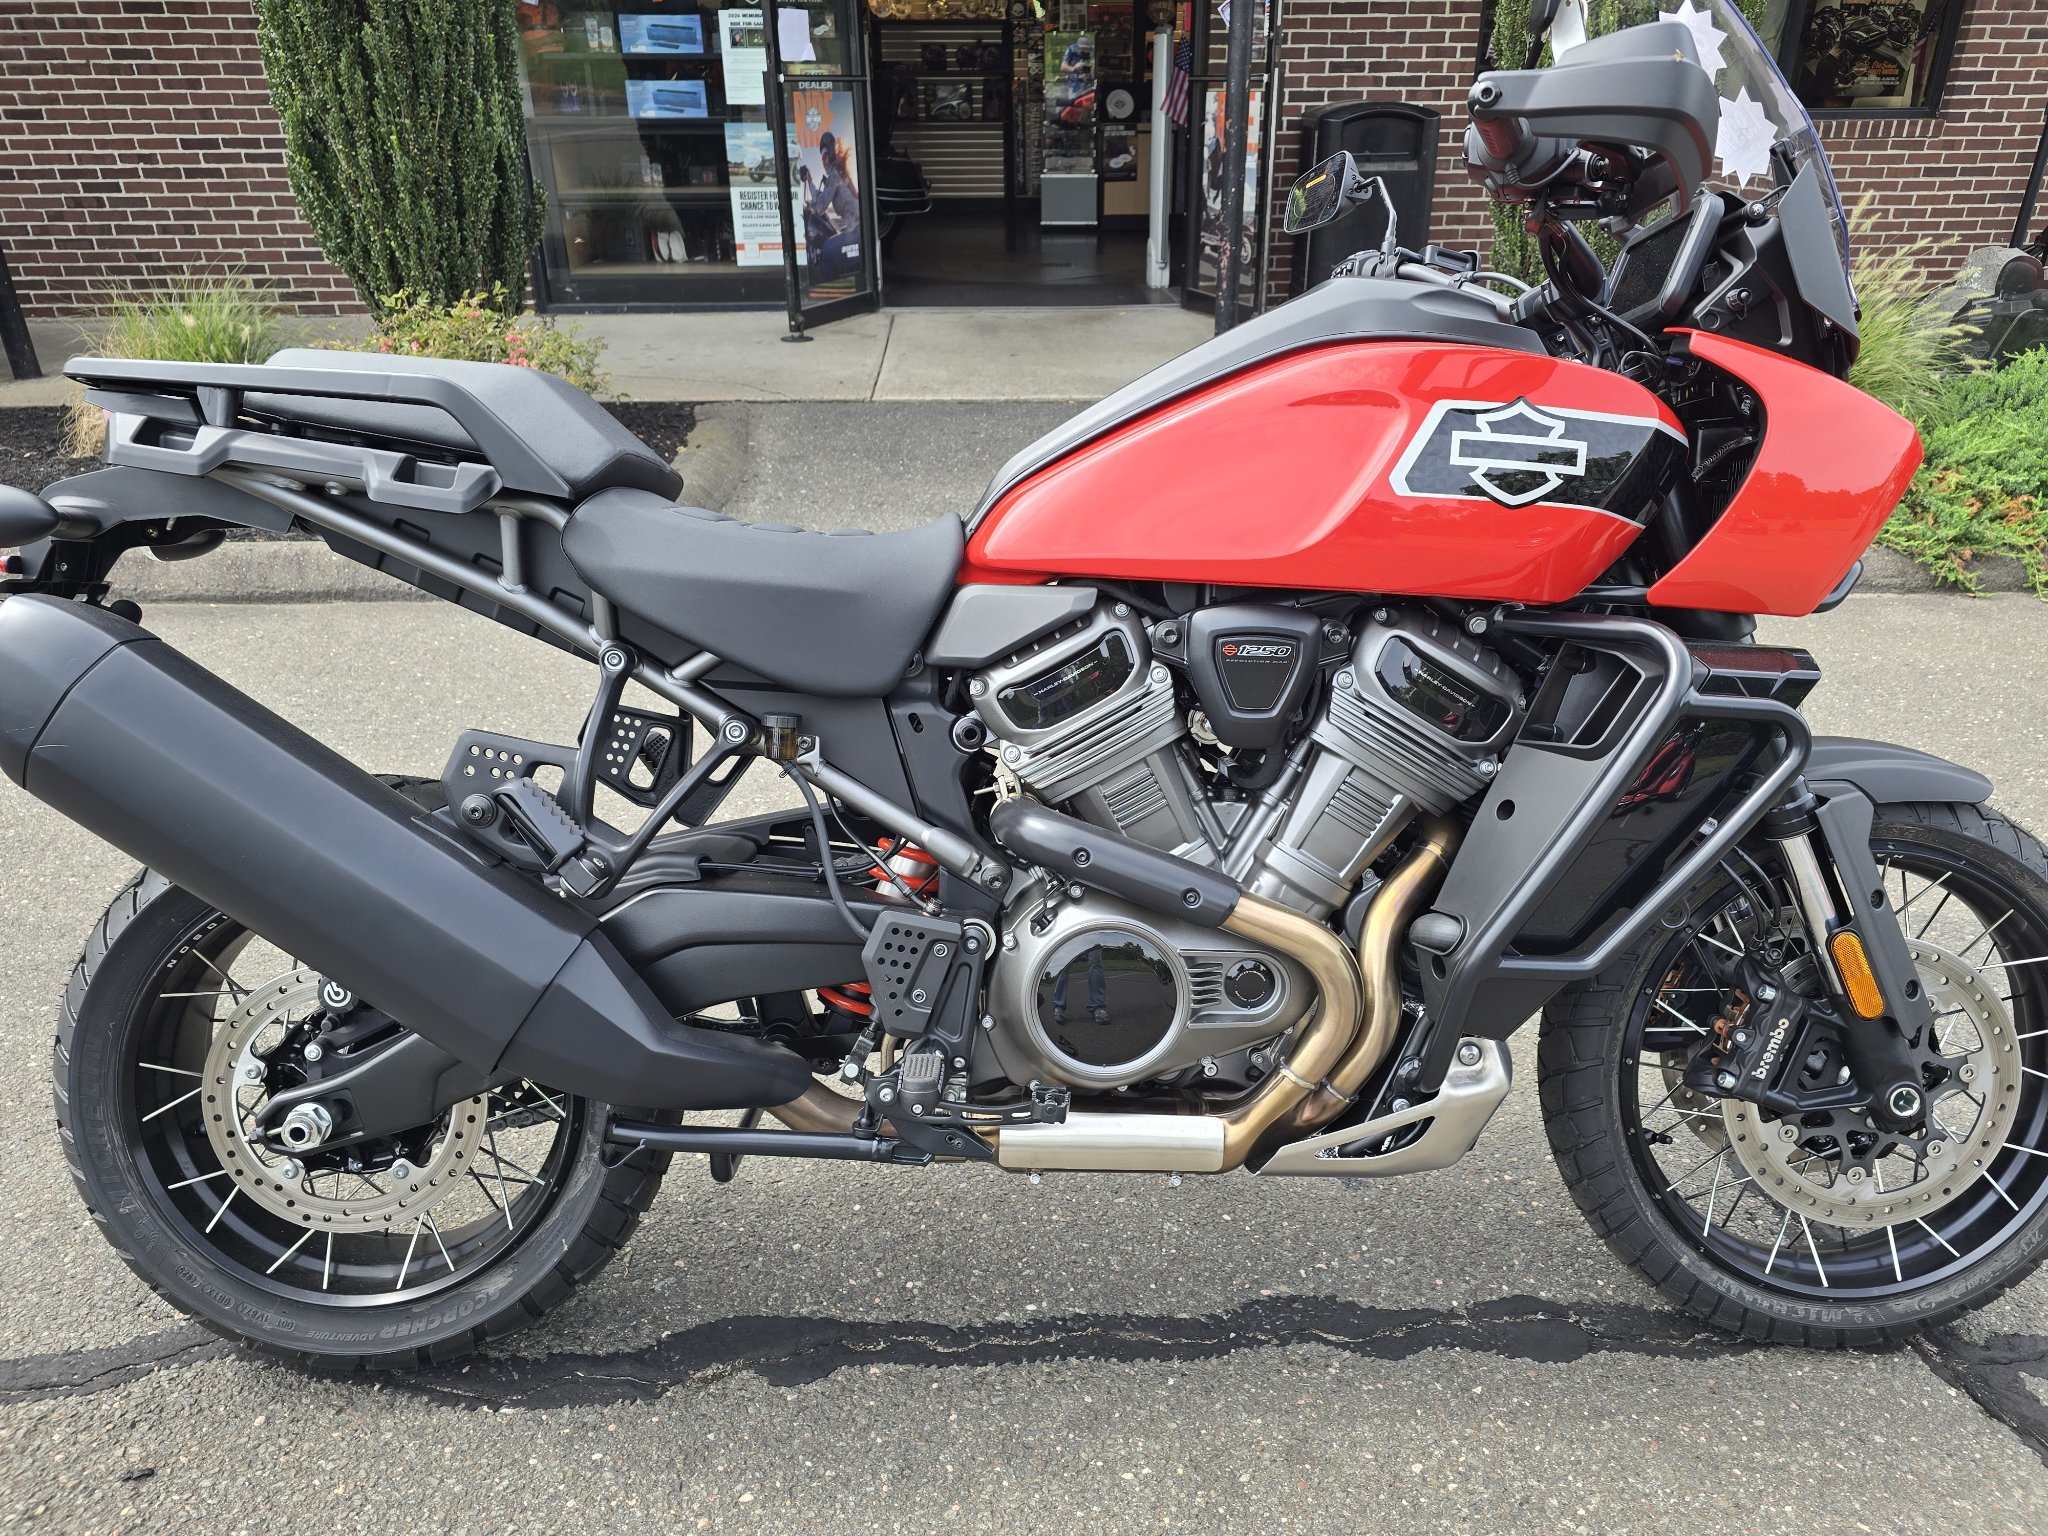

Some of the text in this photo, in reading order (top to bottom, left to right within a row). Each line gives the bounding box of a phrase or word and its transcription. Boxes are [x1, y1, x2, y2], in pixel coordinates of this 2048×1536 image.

[798, 81, 833, 89] DEALER
[739, 190, 768, 200] REGISTER
[740, 201, 765, 211] CHANCE
[1237, 645, 1292, 657] 1250
[1751, 1018, 1789, 1080] brembo
[305, 1288, 502, 1341] SCORCHER ADVENTURE
